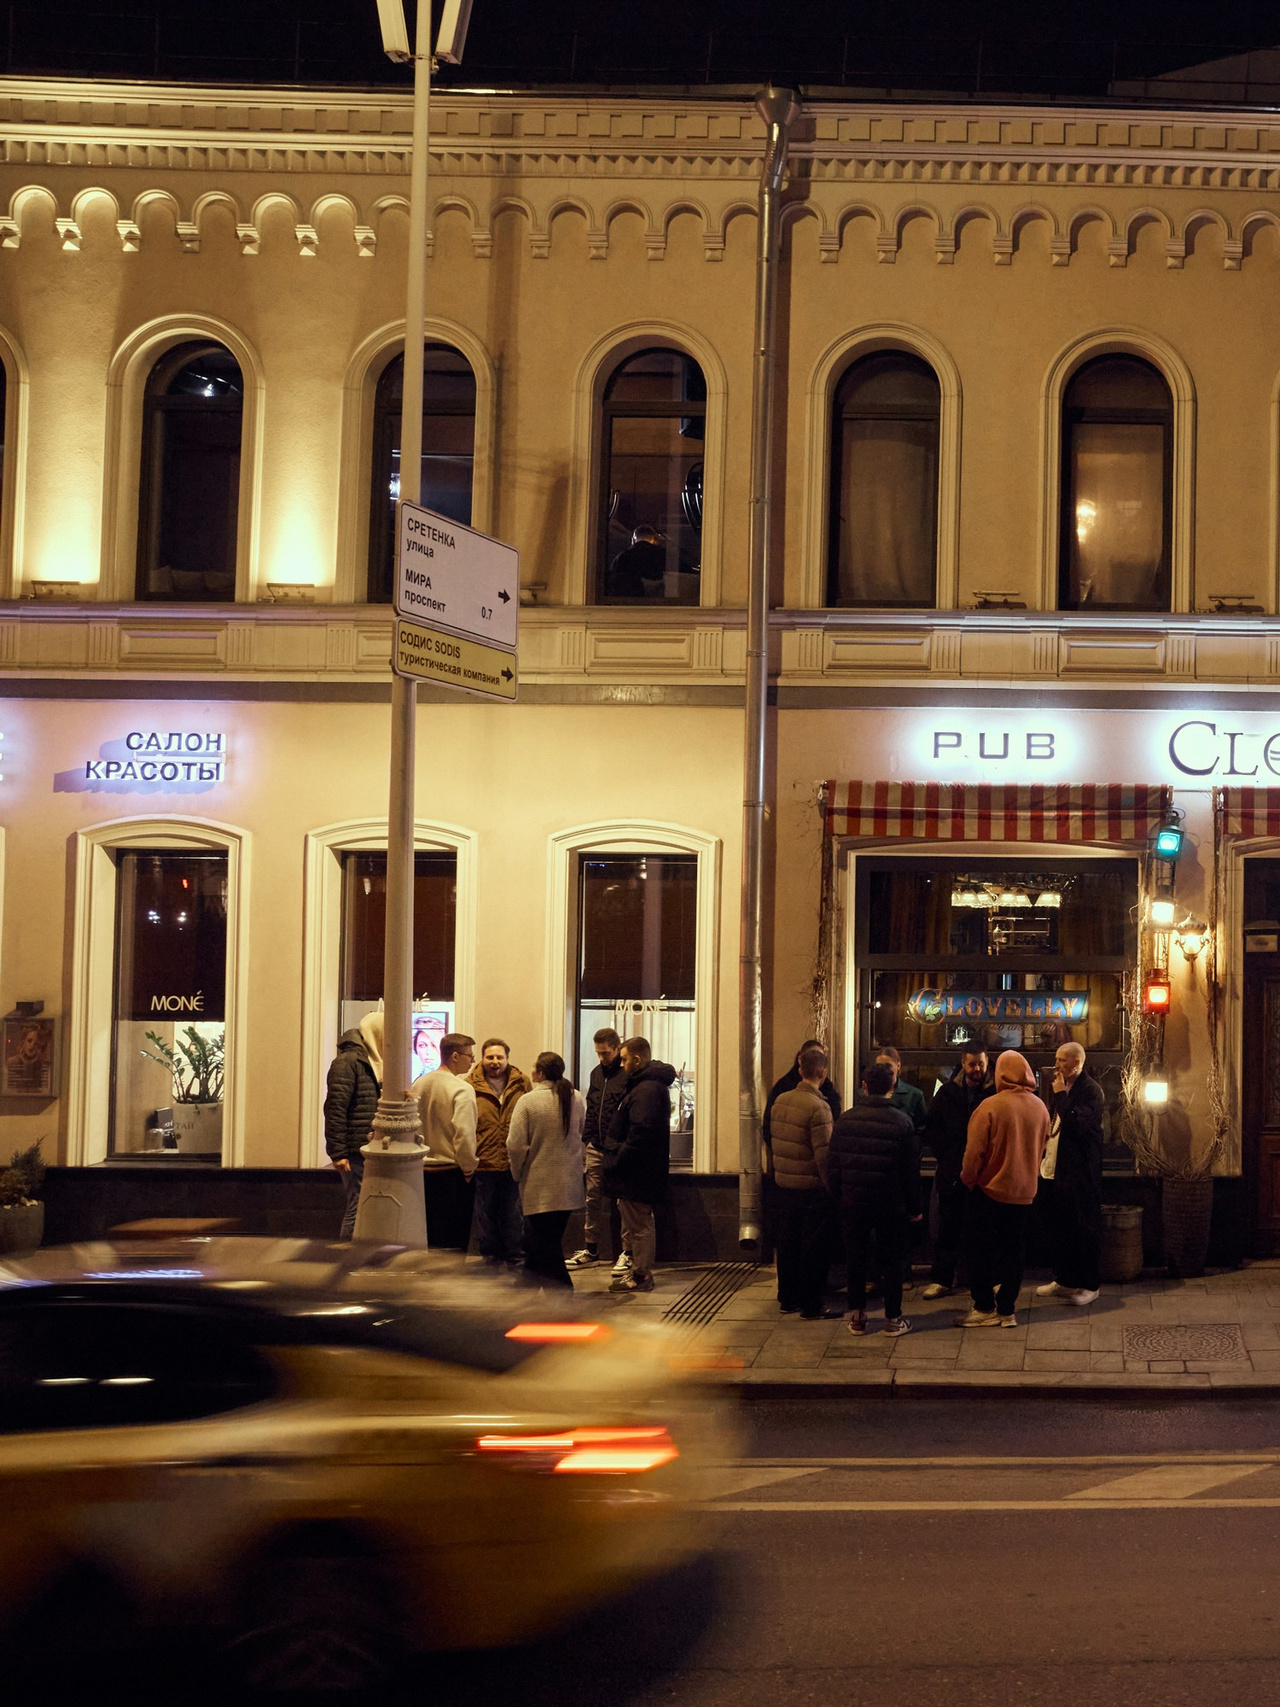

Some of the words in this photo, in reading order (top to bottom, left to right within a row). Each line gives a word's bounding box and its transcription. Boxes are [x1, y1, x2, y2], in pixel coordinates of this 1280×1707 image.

[407, 518, 456, 549] СРЕТЕНКА
[406, 538, 434, 558] улица
[405, 568, 432, 590] МИРА
[404, 590, 446, 613] проспект
[481, 606, 493, 621] 0.7
[400, 630, 432, 650] СОДИС
[435, 641, 461, 659] SODIS
[400, 652, 461, 676] туристическая
[463, 669, 500, 686] компания
[126, 732, 223, 752] САЛОН
[933, 731, 1055, 760] PUB
[86, 760, 222, 781] КРАСОТЫ
[151, 990, 204, 1011] MONÉ
[615, 993, 667, 1016] MONÉ
[907, 987, 1078, 1026] CLOVELLY
